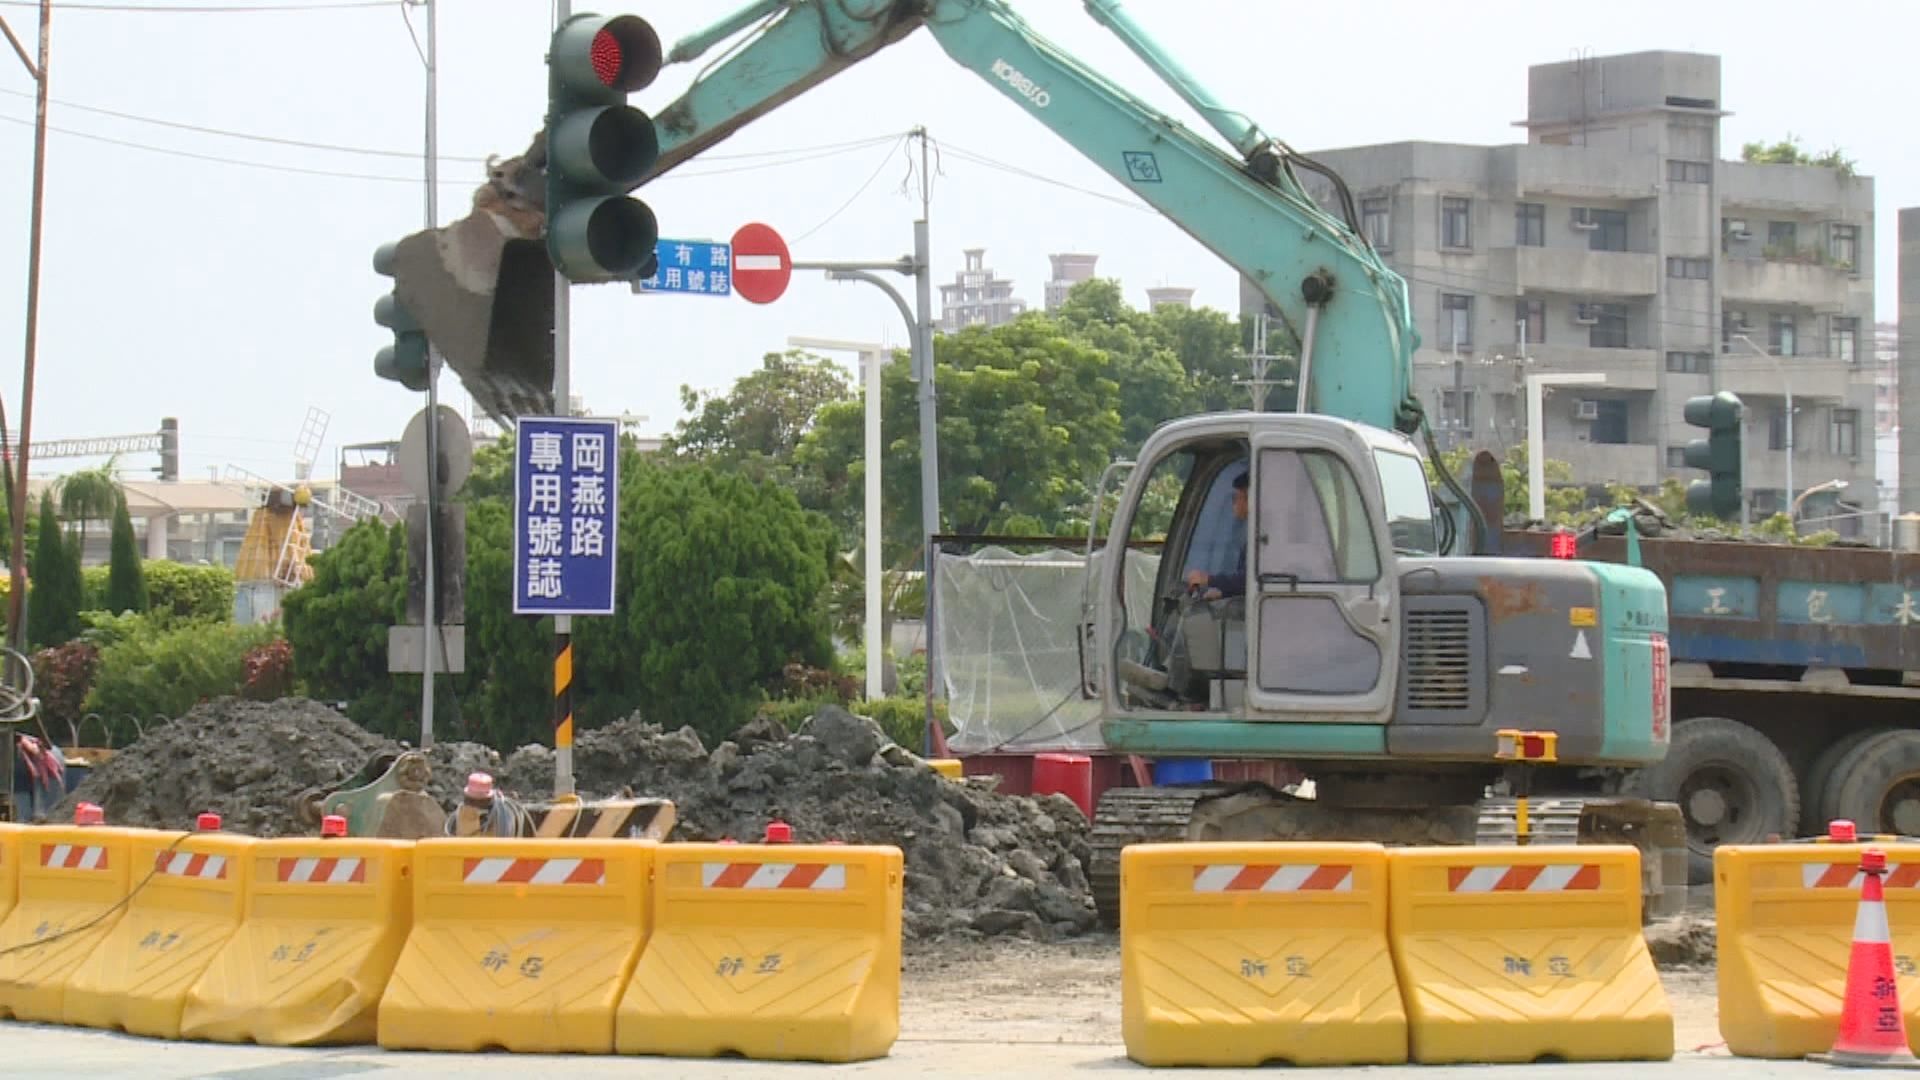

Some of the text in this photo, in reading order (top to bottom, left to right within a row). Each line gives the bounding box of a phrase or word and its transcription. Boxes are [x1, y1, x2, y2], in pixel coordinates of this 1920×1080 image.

[652, 243, 729, 267] 有路
[527, 431, 563, 599] 專用號誌
[570, 432, 605, 557] 岡燕路
